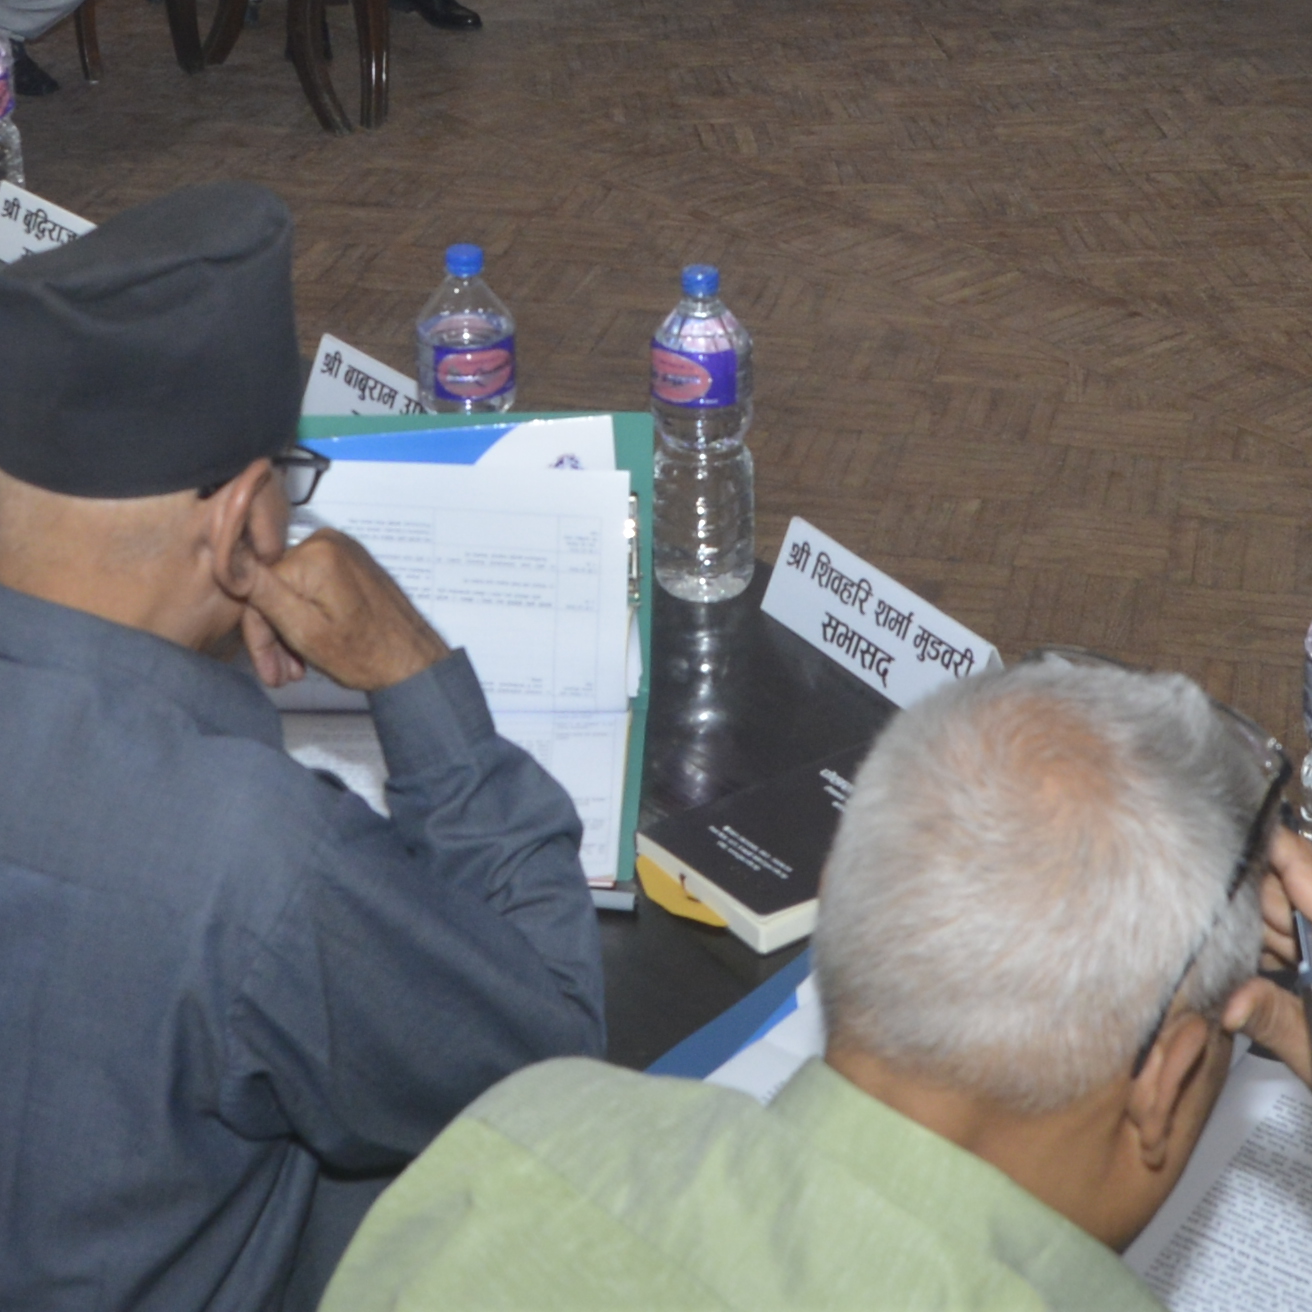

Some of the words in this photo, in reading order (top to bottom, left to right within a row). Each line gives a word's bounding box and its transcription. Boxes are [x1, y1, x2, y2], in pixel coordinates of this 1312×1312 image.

[0, 197, 22, 222] श्री
[320, 350, 343, 379] श्री
[343, 363, 399, 410] बाबुराम
[786, 541, 812, 573] श्री
[810, 551, 873, 616] शिवहरि
[874, 599, 915, 641] शर्मा
